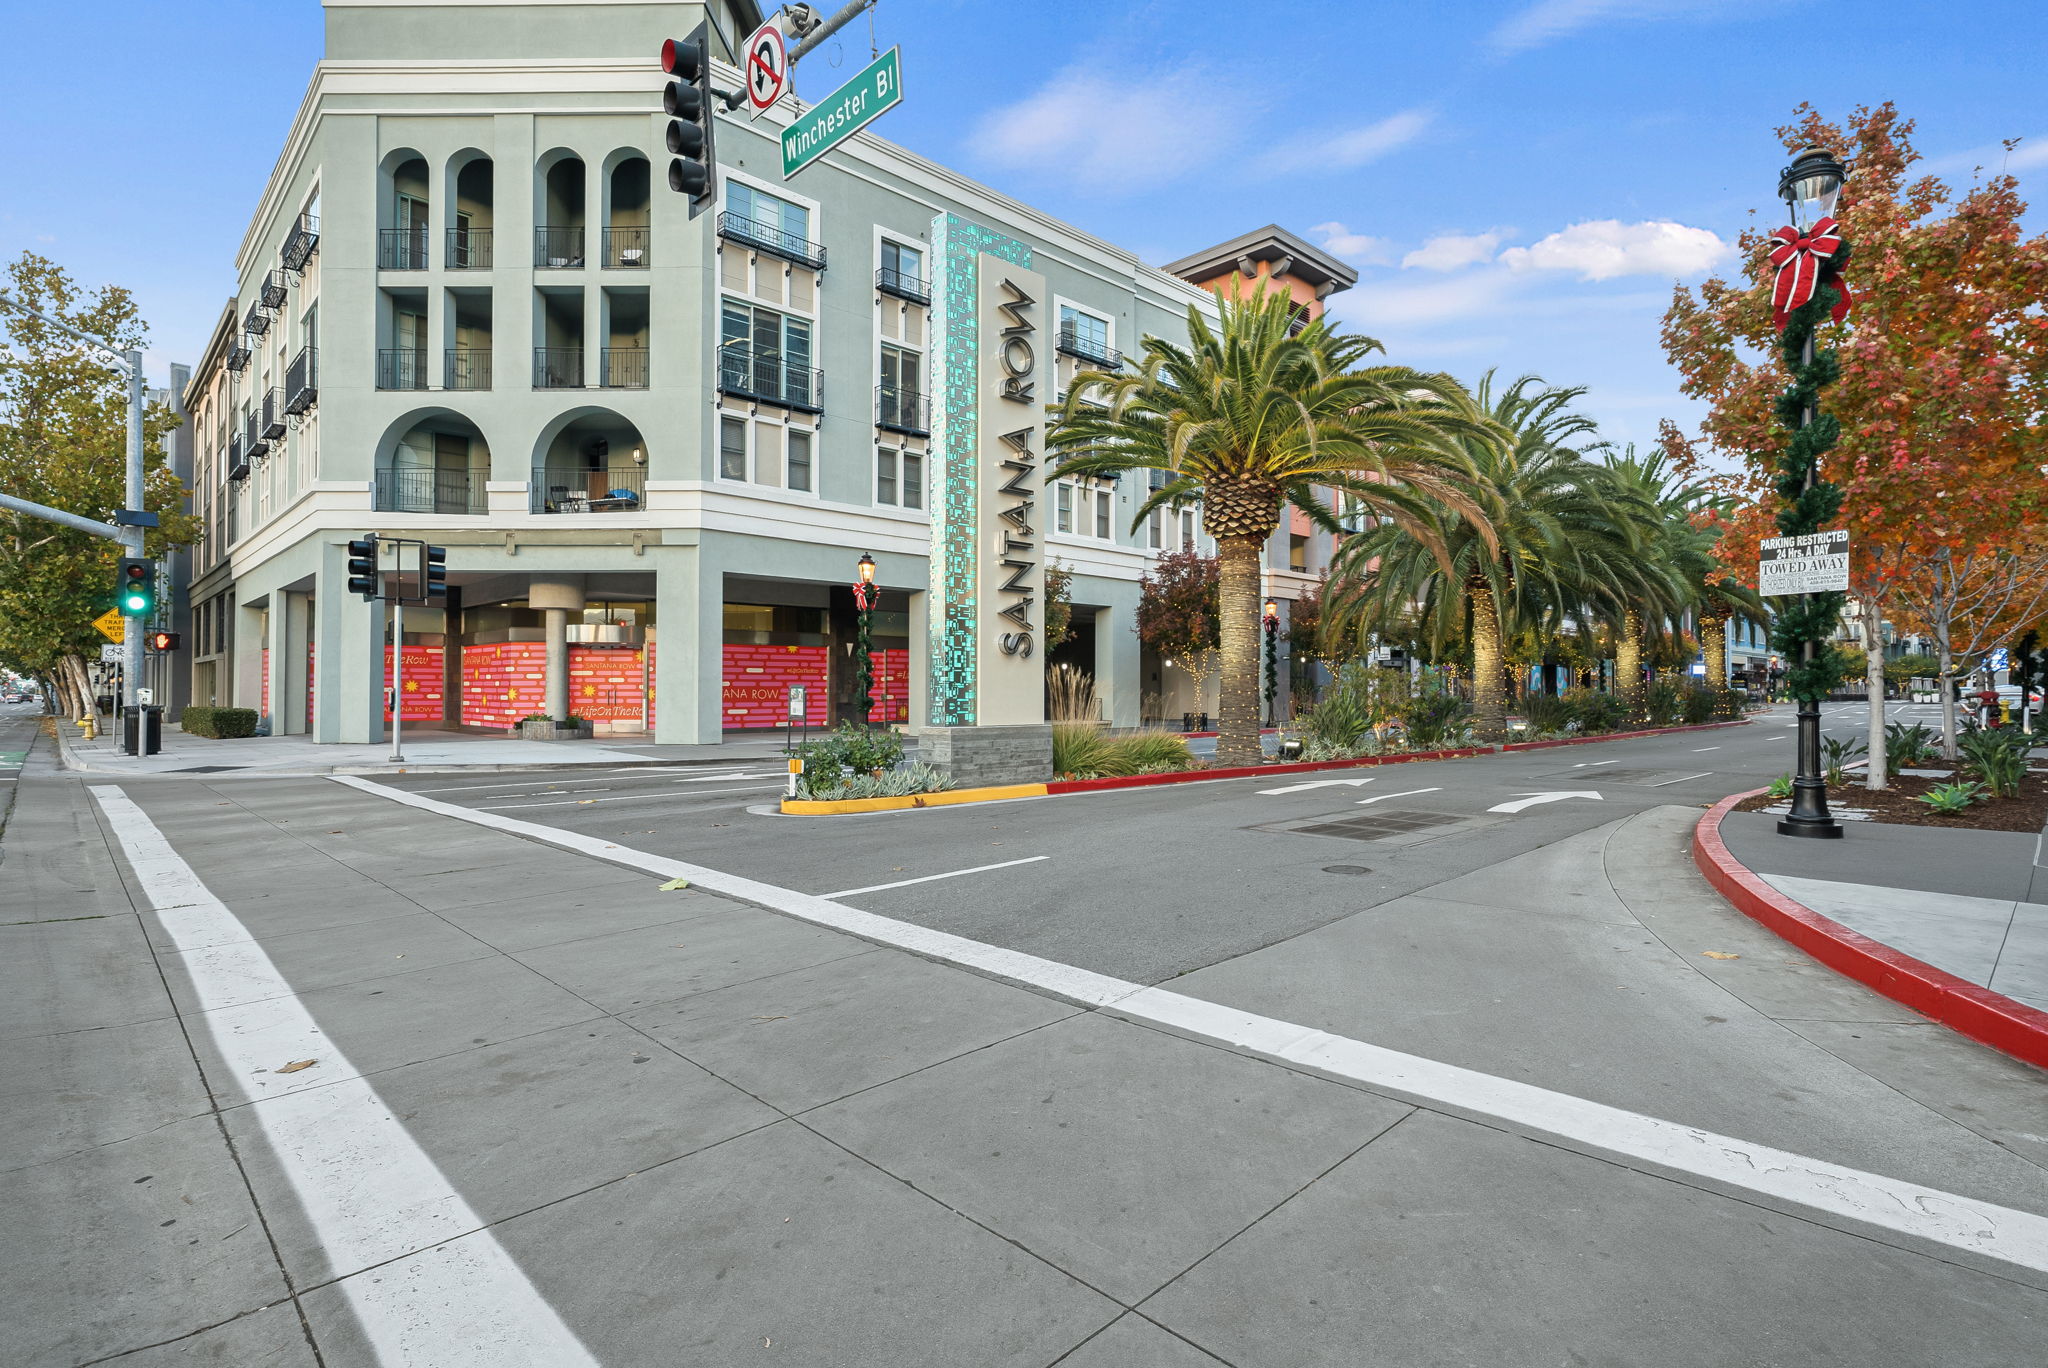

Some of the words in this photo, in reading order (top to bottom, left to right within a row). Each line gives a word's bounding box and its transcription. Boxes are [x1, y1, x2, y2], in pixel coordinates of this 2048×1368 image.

[786, 88, 868, 162] Winchester
[998, 277, 1036, 404] ROW
[998, 425, 1036, 659] SANTANA
[1760, 537, 1795, 550] PARKING
[1797, 530, 1848, 547] RESTRICTED
[1776, 548, 1787, 560] 24
[1788, 547, 1804, 559] Hrs.
[1806, 545, 1812, 557] A
[1813, 543, 1830, 556] DAY
[1762, 561, 1806, 575] TOWED
[1810, 557, 1846, 571] AWAY
[385, 655, 429, 665] TeRow
[751, 688, 779, 699] ROW
[572, 705, 643, 718] #LifeOnTheRo
